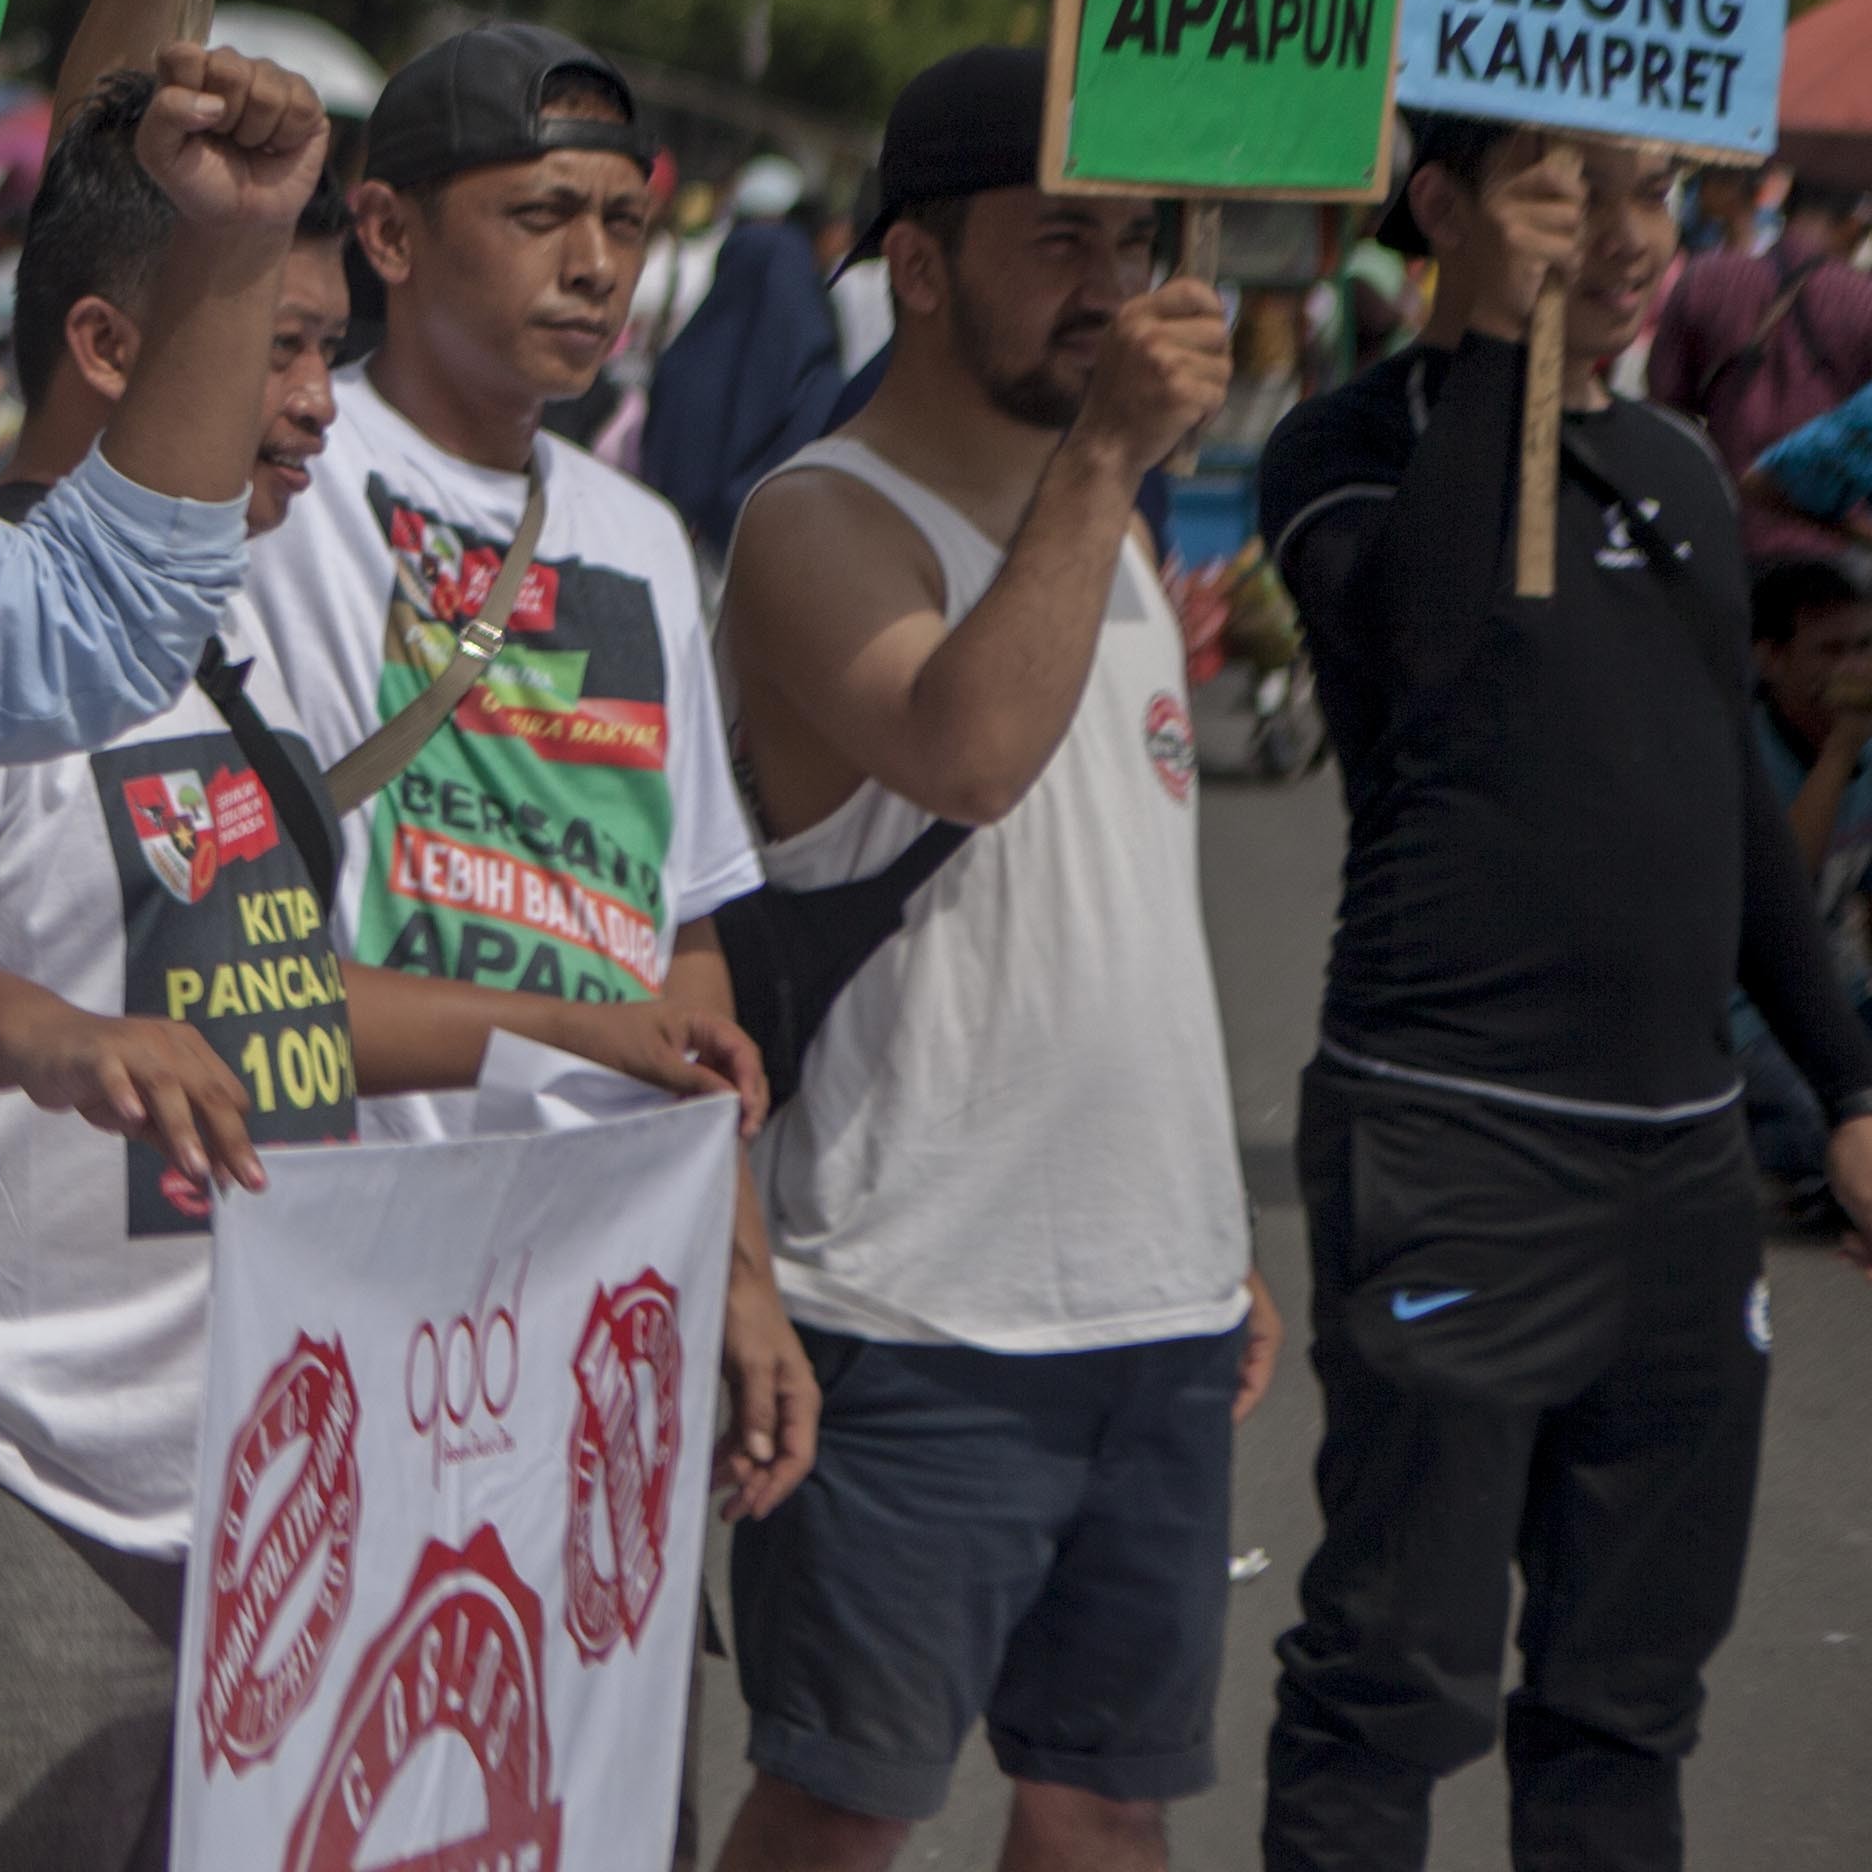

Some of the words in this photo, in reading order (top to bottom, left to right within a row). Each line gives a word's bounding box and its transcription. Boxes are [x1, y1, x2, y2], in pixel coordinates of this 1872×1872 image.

[1435, 8, 1745, 119] KAMPRET
[237, 886, 322, 947] KITA
[397, 834, 515, 913] LEBIH
[382, 911, 627, 1004] APAP
